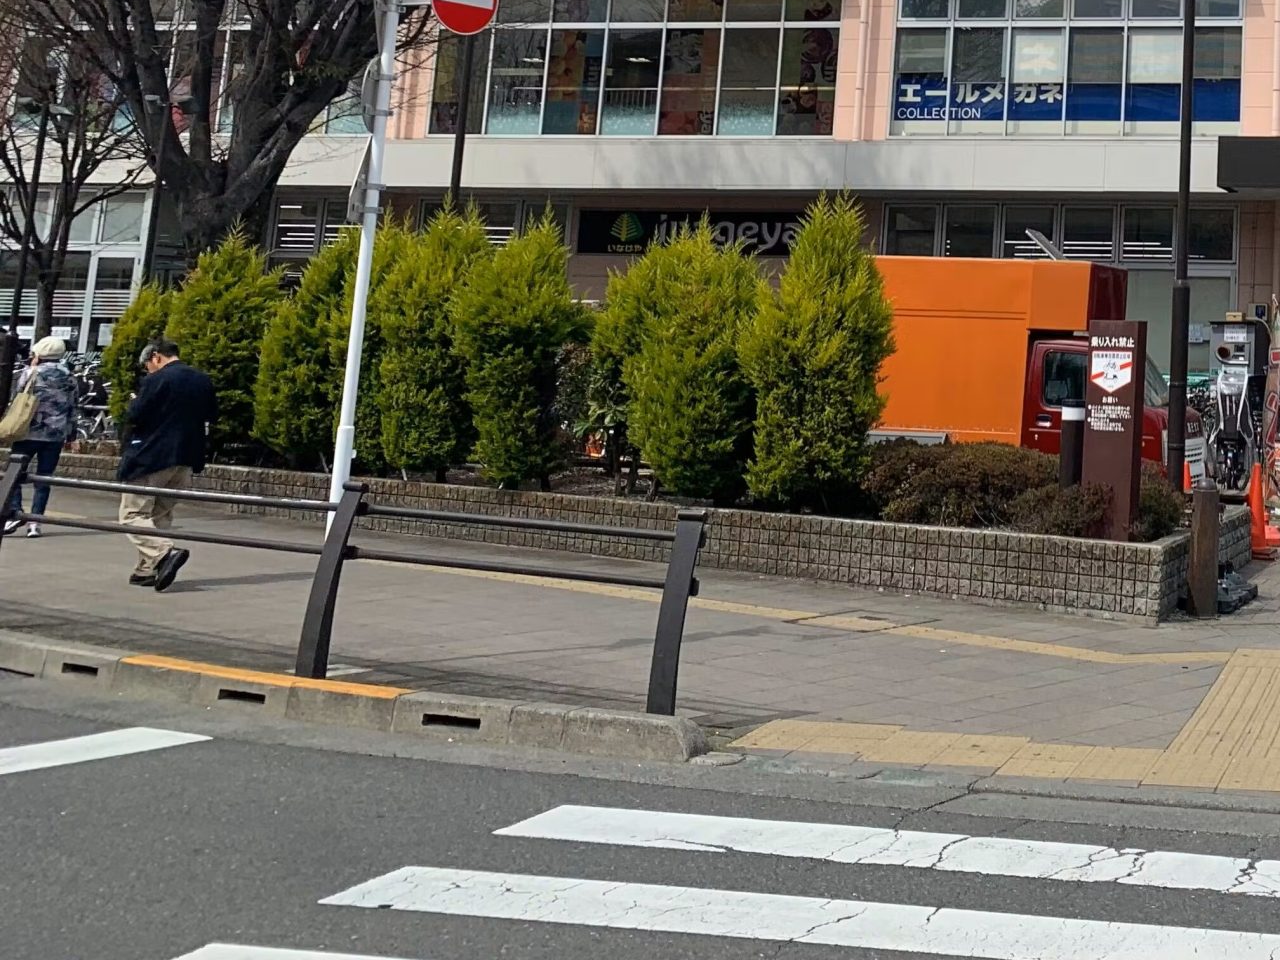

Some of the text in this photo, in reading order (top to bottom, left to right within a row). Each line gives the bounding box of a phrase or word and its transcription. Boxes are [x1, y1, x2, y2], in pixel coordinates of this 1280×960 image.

[898, 83, 1063, 105] エールメガネ
[897, 107, 981, 119] COLLECTION
[660, 214, 803, 251] igeya
[1091, 336, 1135, 348] 乗り入れ禁止
